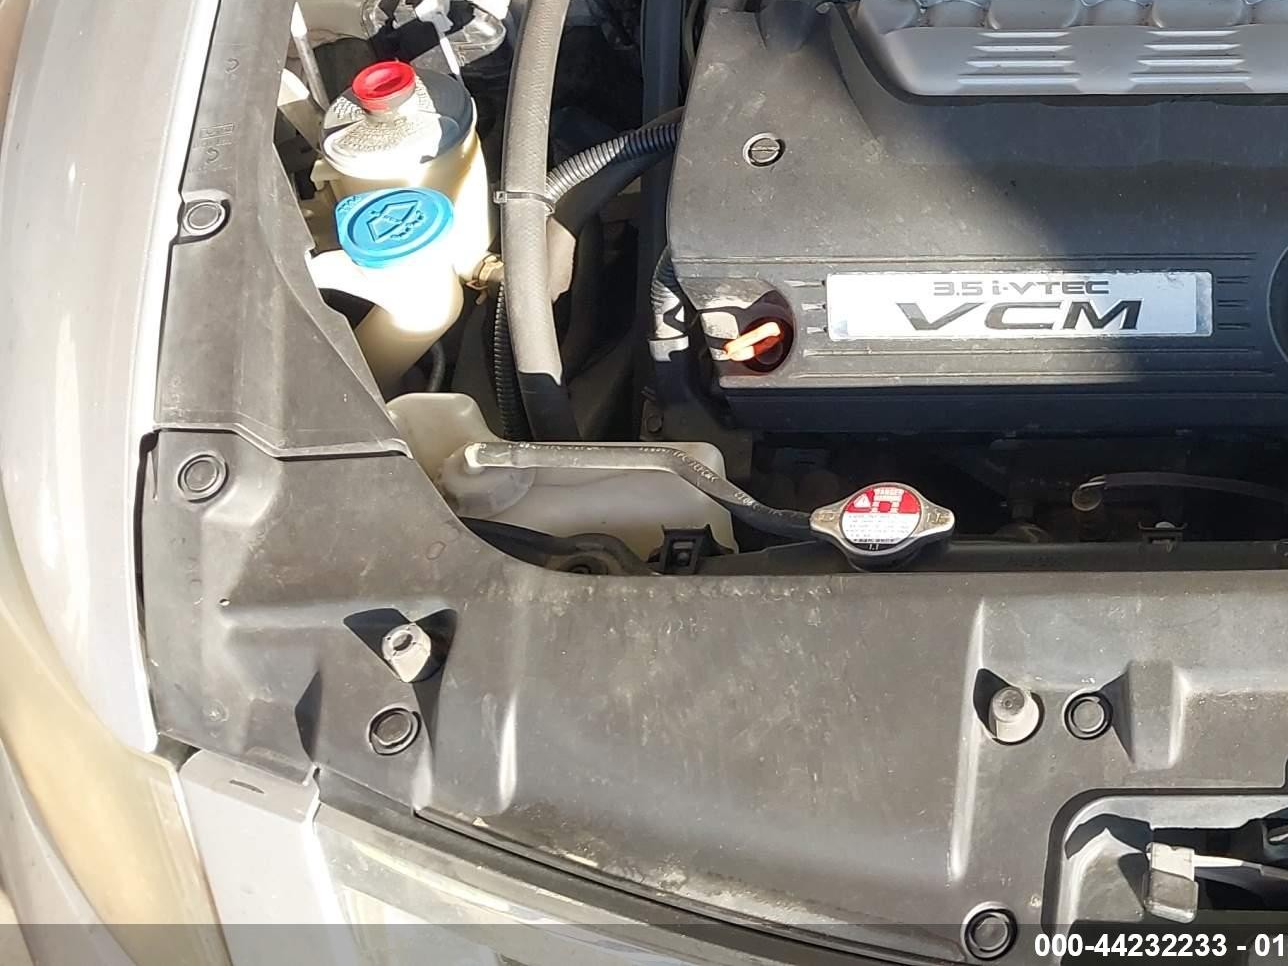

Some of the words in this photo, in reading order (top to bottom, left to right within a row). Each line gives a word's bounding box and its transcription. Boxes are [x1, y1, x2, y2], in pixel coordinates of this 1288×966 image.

[933, 281, 984, 296] 3.5
[992, 280, 1110, 295] i-VTEC
[896, 300, 1144, 331] VCM
